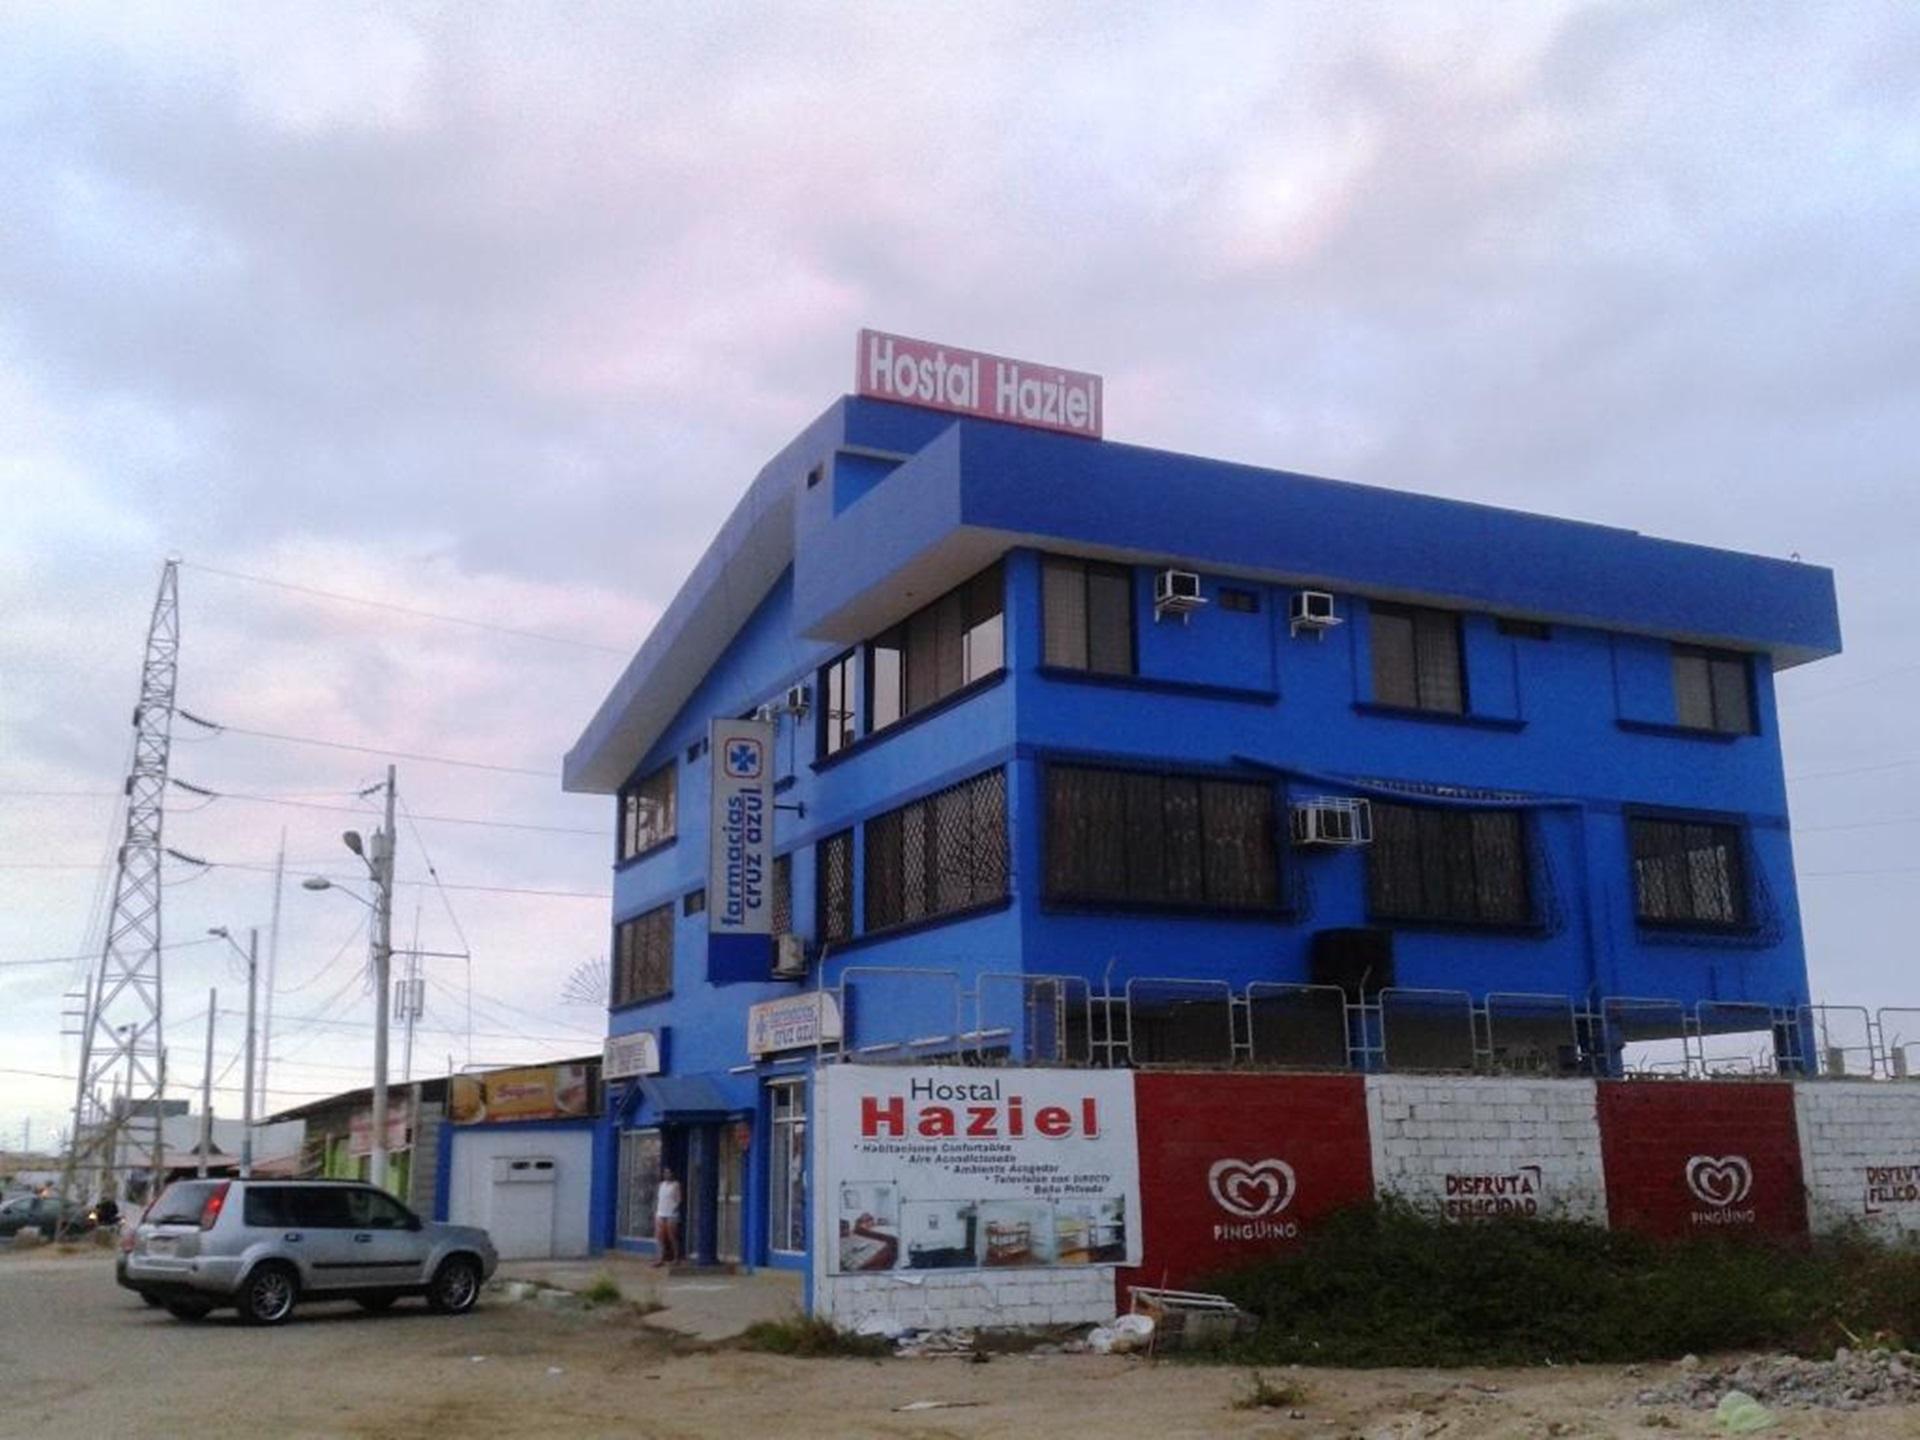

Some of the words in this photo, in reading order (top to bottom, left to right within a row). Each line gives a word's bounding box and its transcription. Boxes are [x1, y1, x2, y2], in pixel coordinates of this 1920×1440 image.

[869, 336, 980, 409] Hostal
[996, 362, 1096, 431] Haziel
[741, 787, 763, 845] azul
[721, 796, 744, 926] farmacias
[746, 853, 763, 910] cruz
[861, 1095, 1099, 1138] Haziel
[911, 1077, 1000, 1101] Hostal
[1446, 1174, 1534, 1196] DISFRUTA
